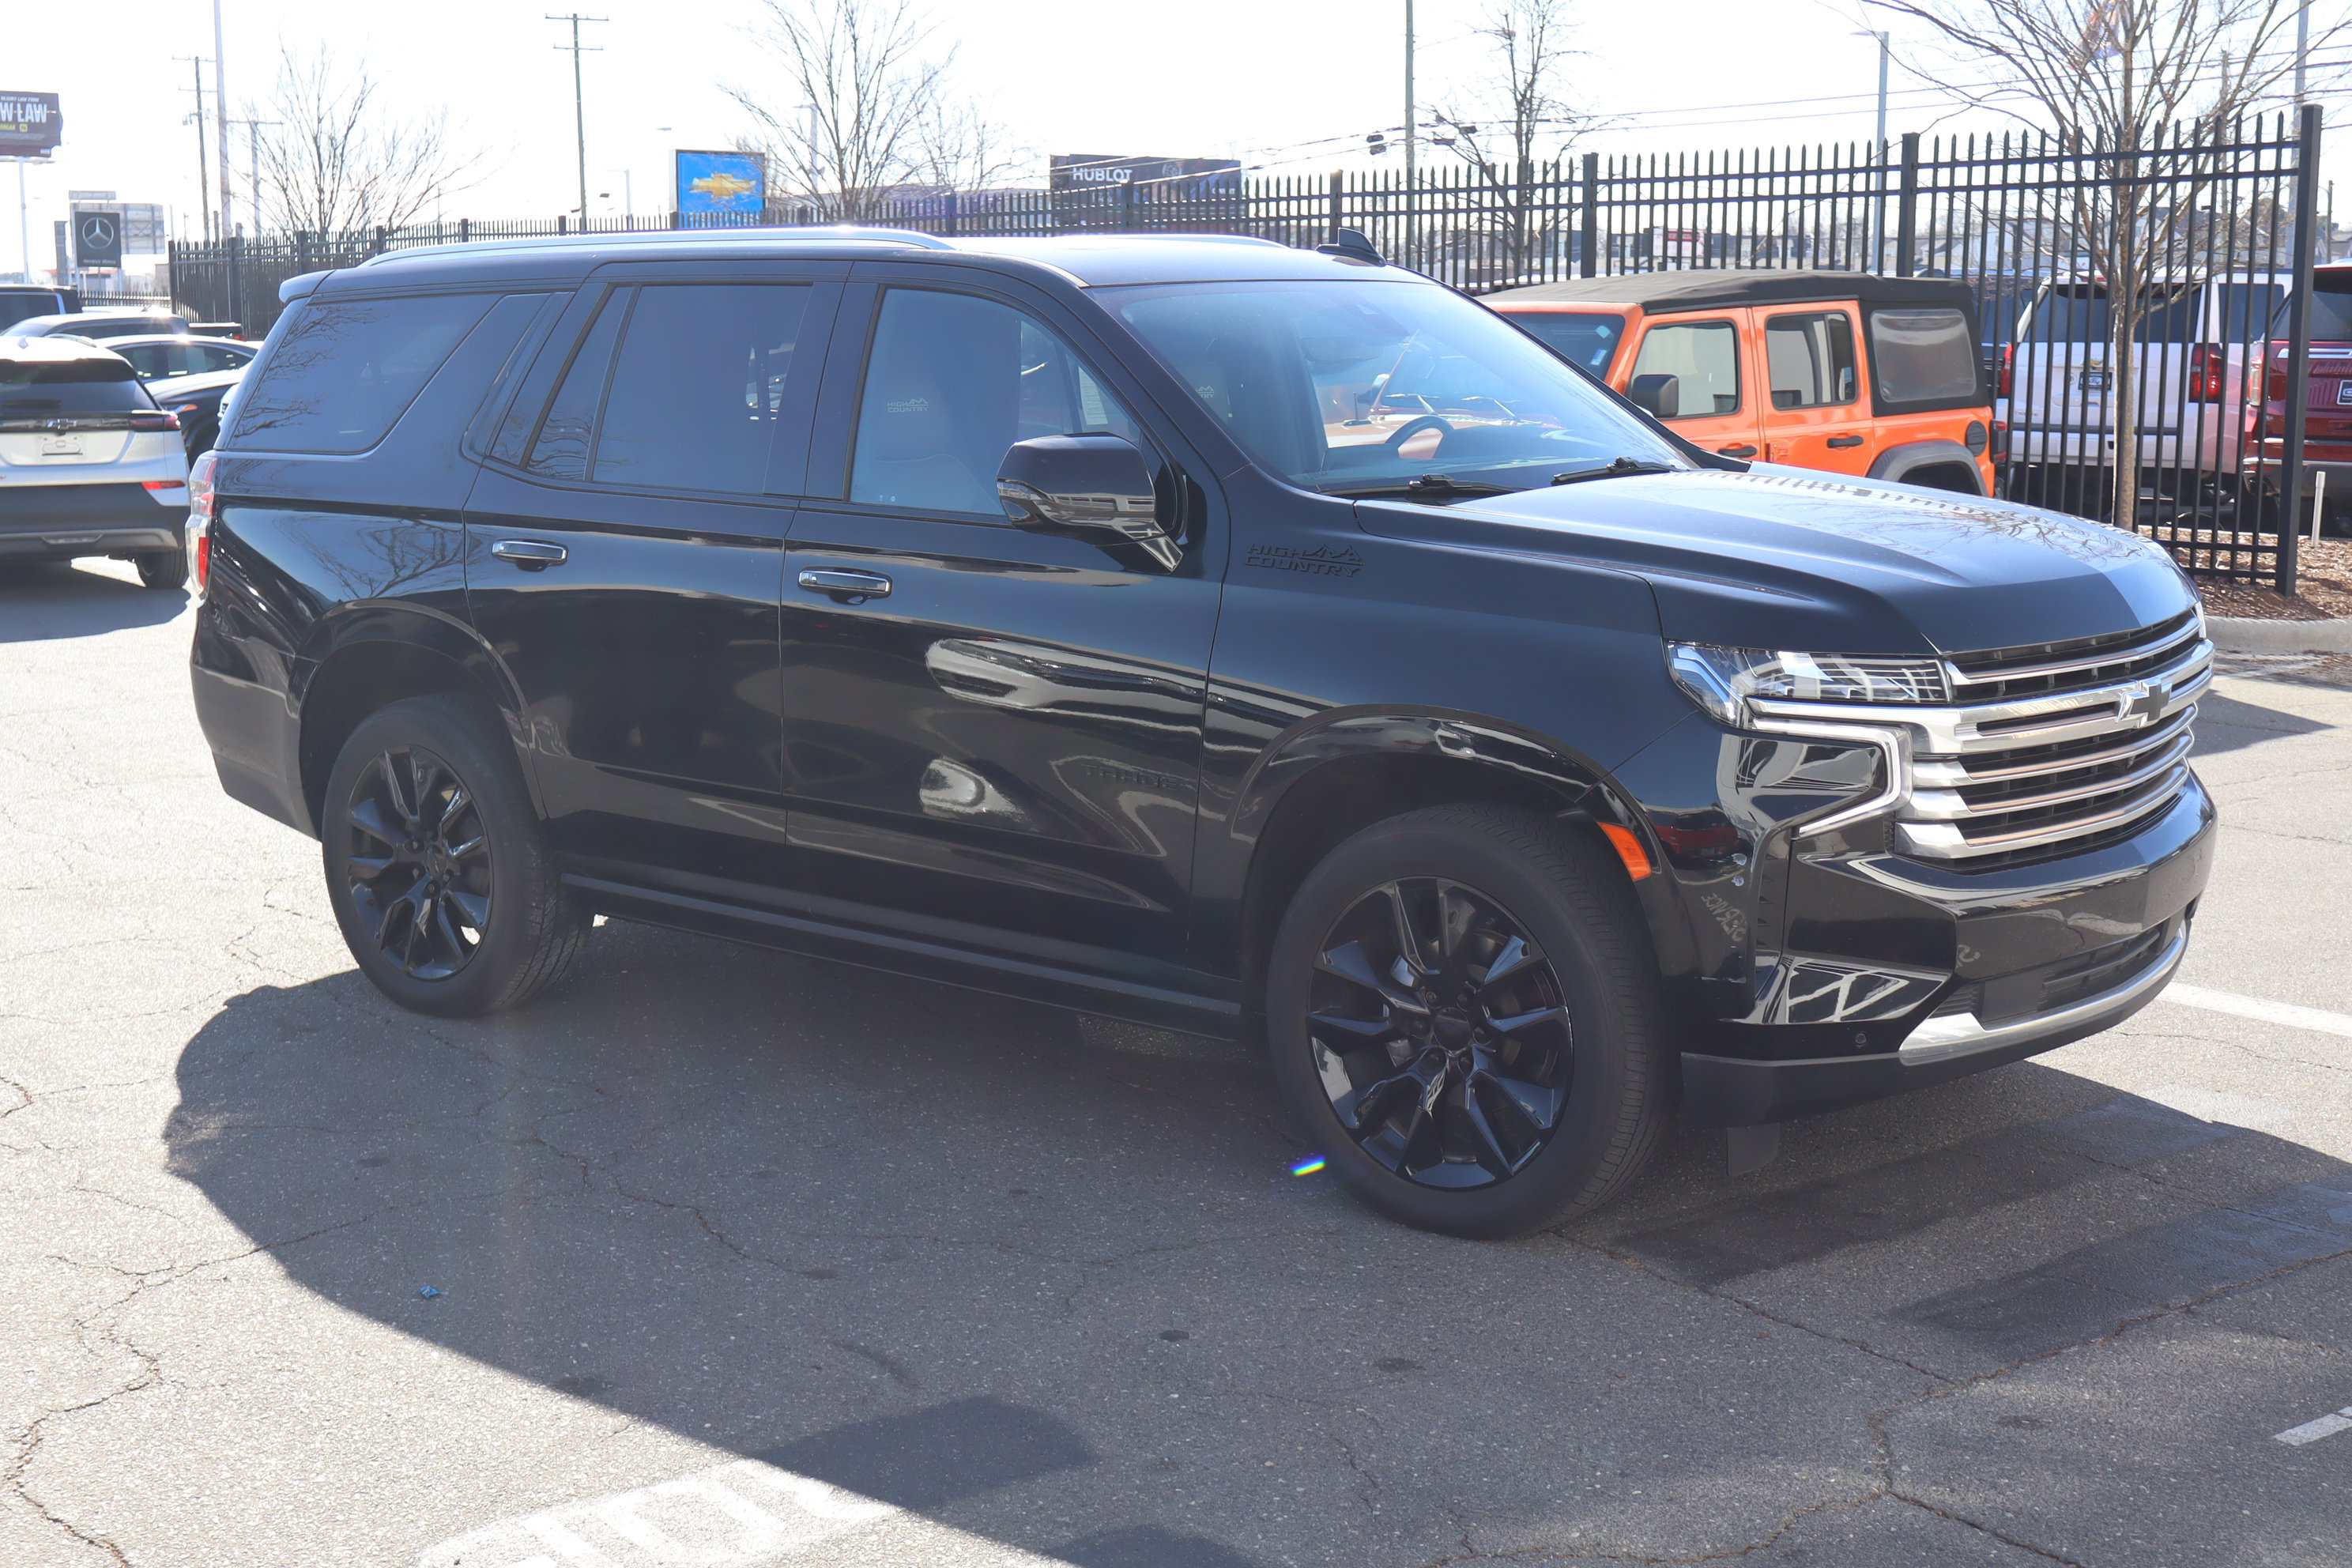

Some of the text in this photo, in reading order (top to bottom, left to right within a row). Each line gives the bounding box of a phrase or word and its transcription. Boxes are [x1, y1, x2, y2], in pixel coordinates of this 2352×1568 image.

[17, 103, 47, 123] LAW
[1072, 167, 1133, 182] HUBLOT
[1243, 556, 1362, 578] COUNTRY
[1080, 763, 1178, 791] TAHOE
